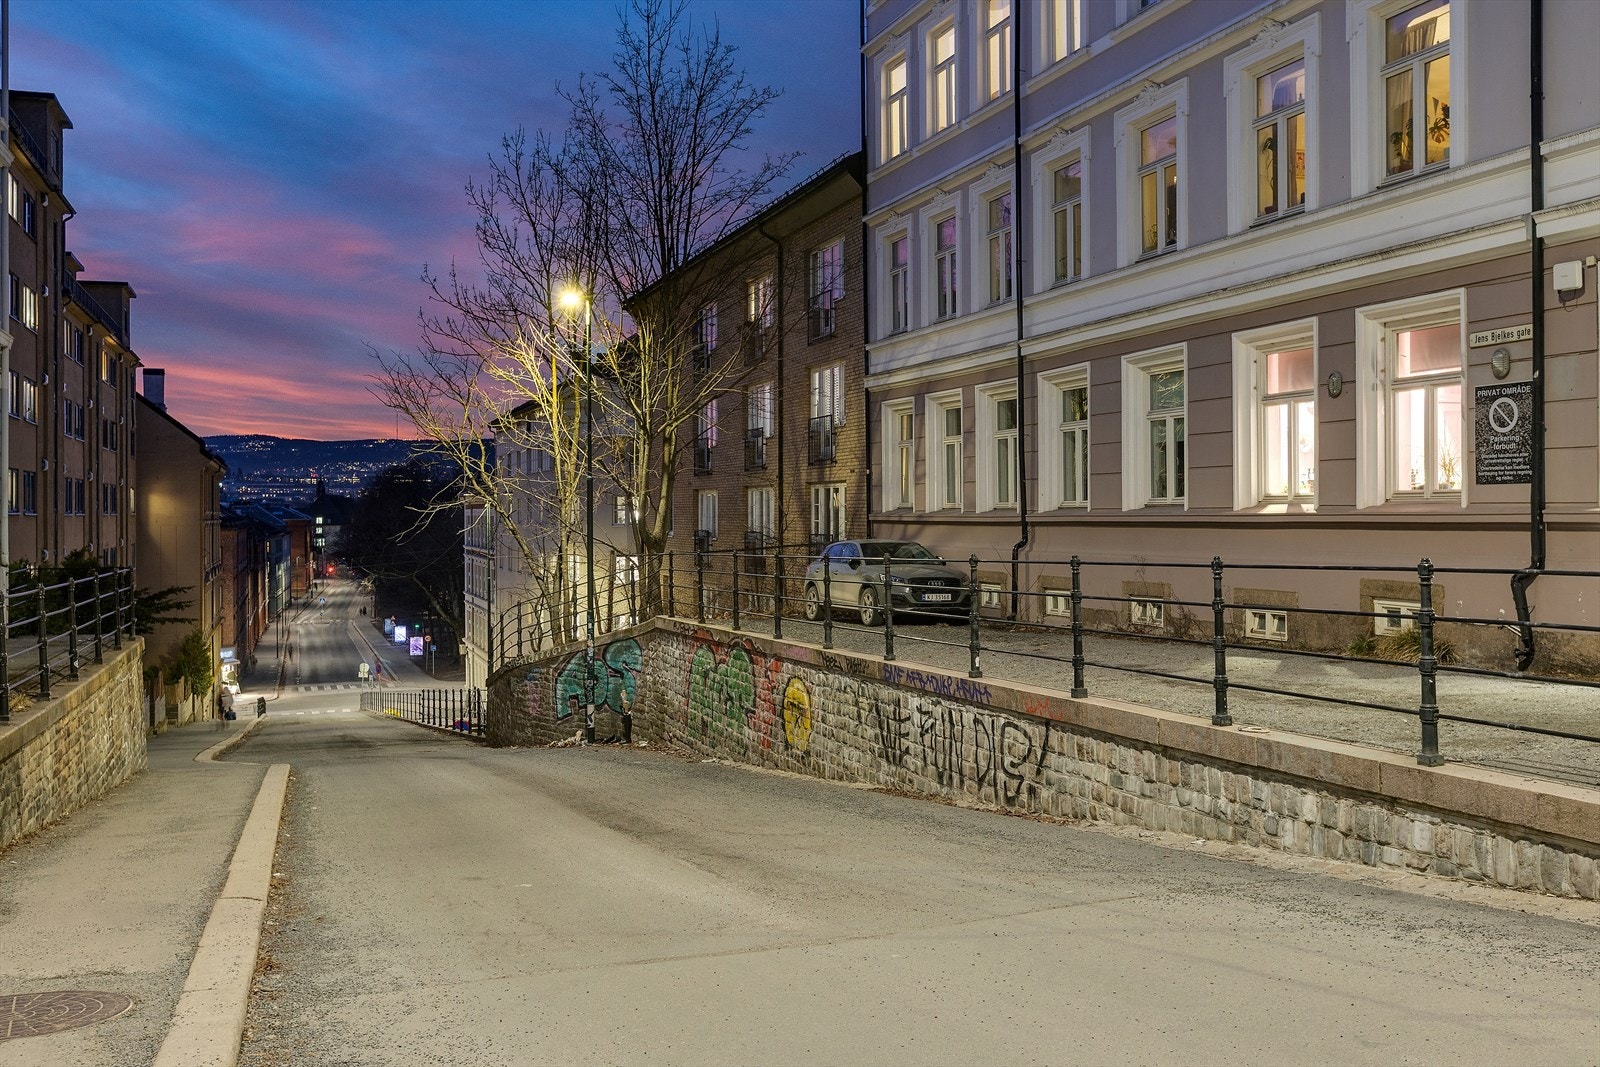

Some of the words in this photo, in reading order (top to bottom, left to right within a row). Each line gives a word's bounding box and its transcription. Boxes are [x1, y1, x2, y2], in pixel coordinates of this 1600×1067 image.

[1474, 335, 1489, 344] Jens
[1491, 331, 1514, 342] Bjelkes
[1516, 327, 1531, 339] gate
[1477, 388, 1500, 398] PRIVAT
[1501, 384, 1531, 395] OMRÅDE
